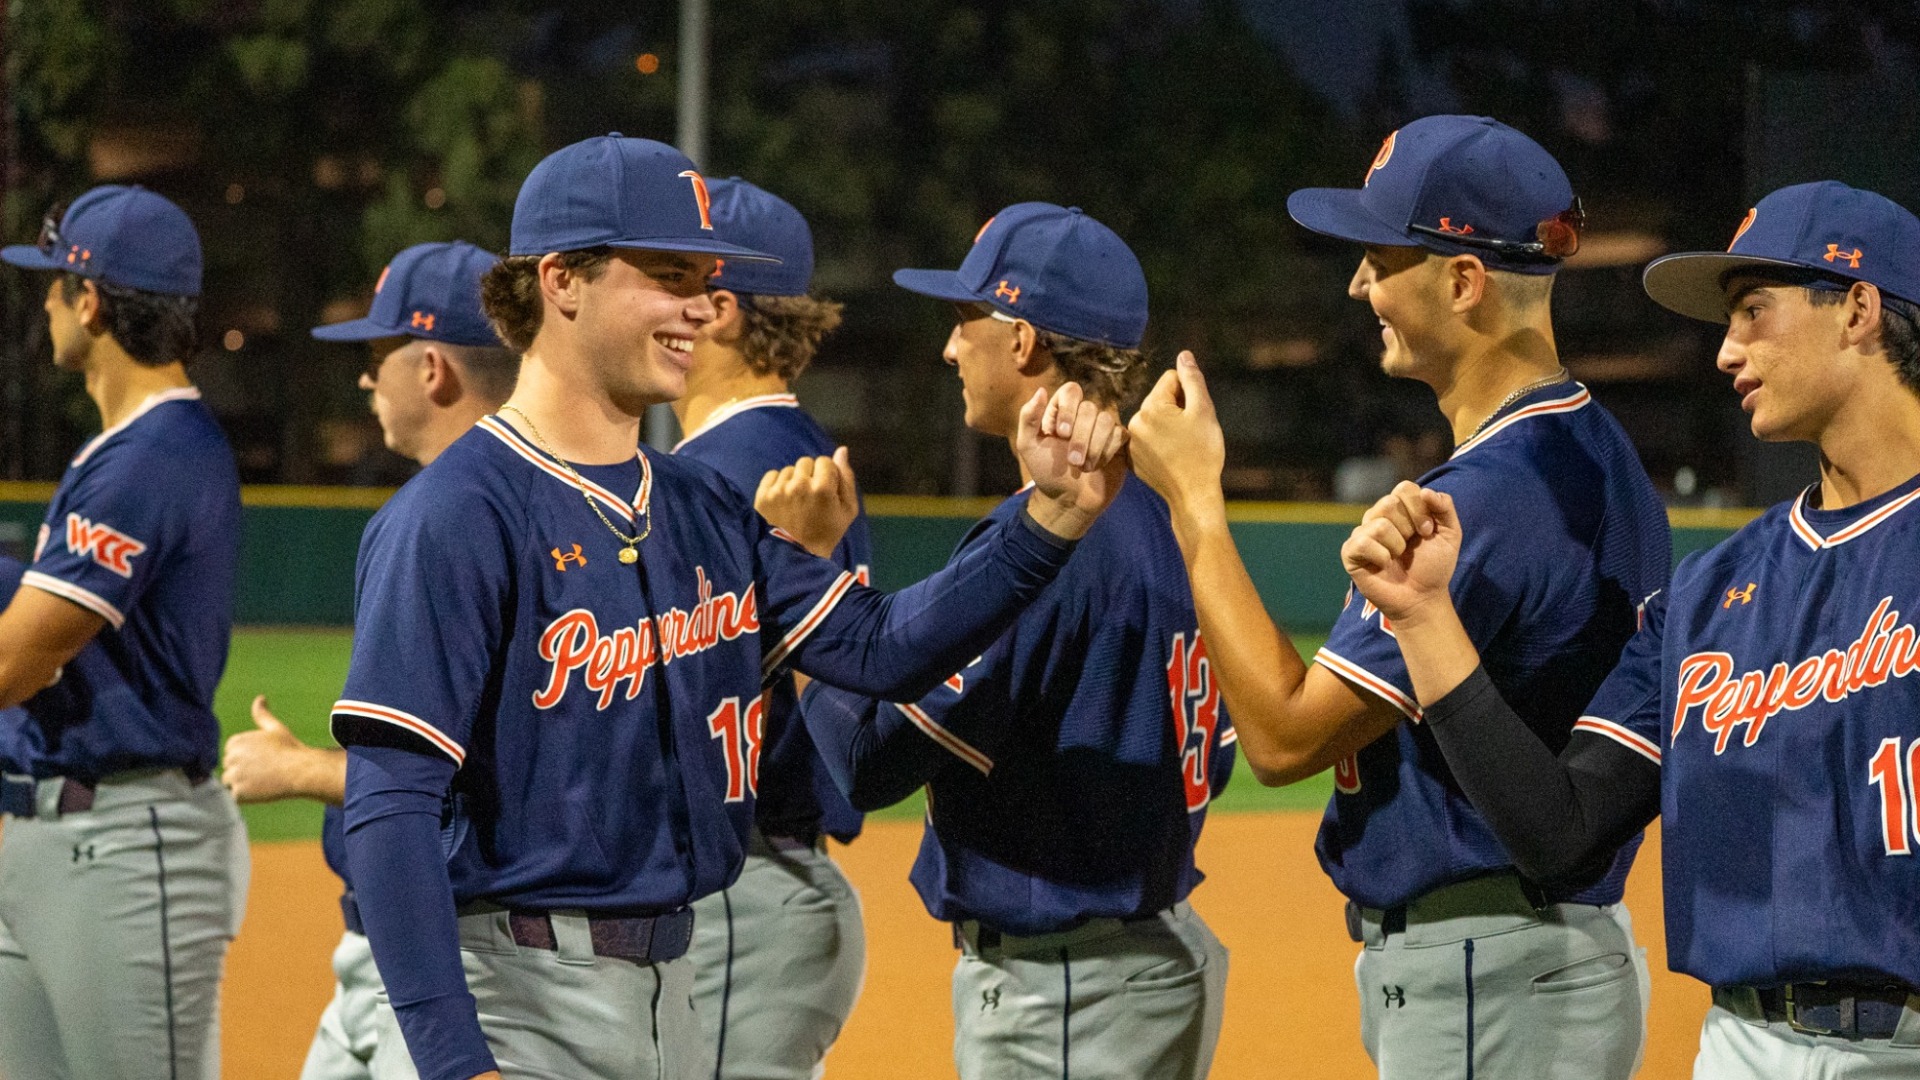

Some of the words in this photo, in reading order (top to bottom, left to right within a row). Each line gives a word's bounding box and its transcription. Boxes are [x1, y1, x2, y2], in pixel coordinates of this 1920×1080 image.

[67, 512, 147, 579] WCC
[1166, 629, 1221, 814] 13
[1671, 595, 1920, 755] Pepperdin
